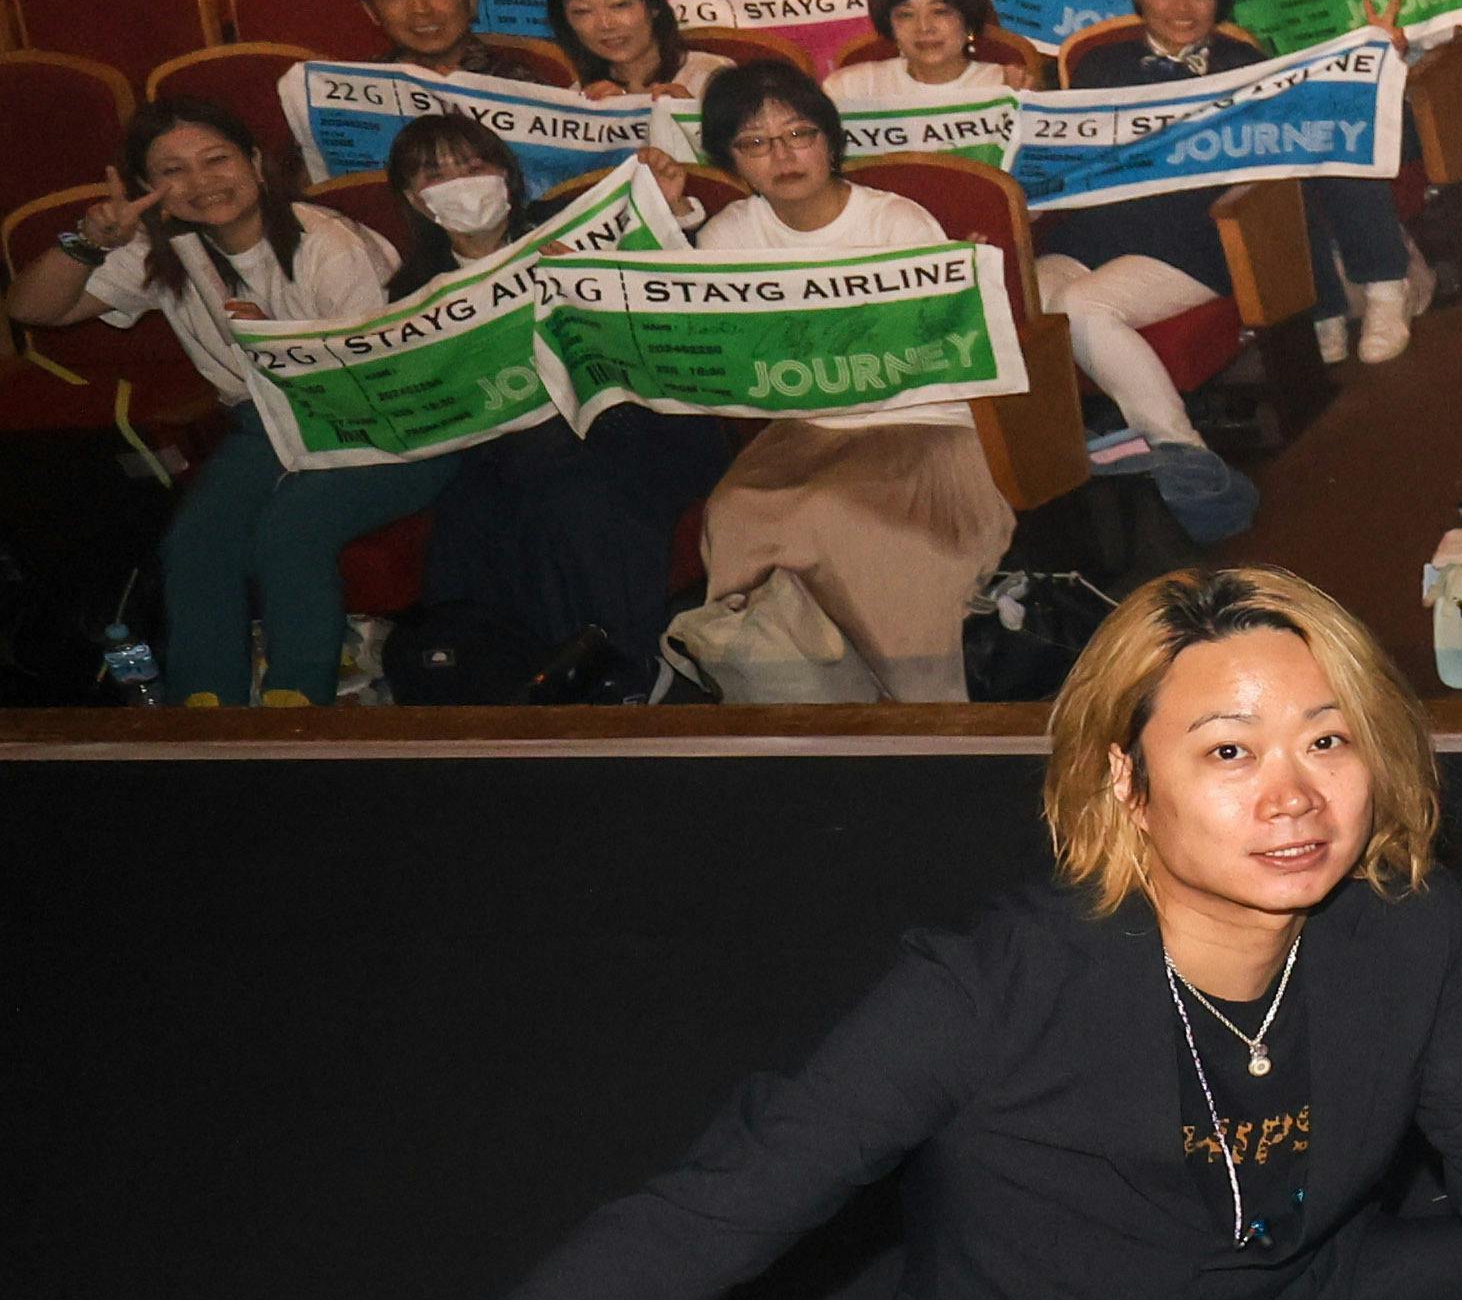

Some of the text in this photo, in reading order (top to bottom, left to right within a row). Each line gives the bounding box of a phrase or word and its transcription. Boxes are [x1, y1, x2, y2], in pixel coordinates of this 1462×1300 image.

[1167, 119, 1368, 167] JOURNEY
[643, 258, 968, 305] STAYG AIRLINE
[748, 331, 980, 400] JOURNEY
